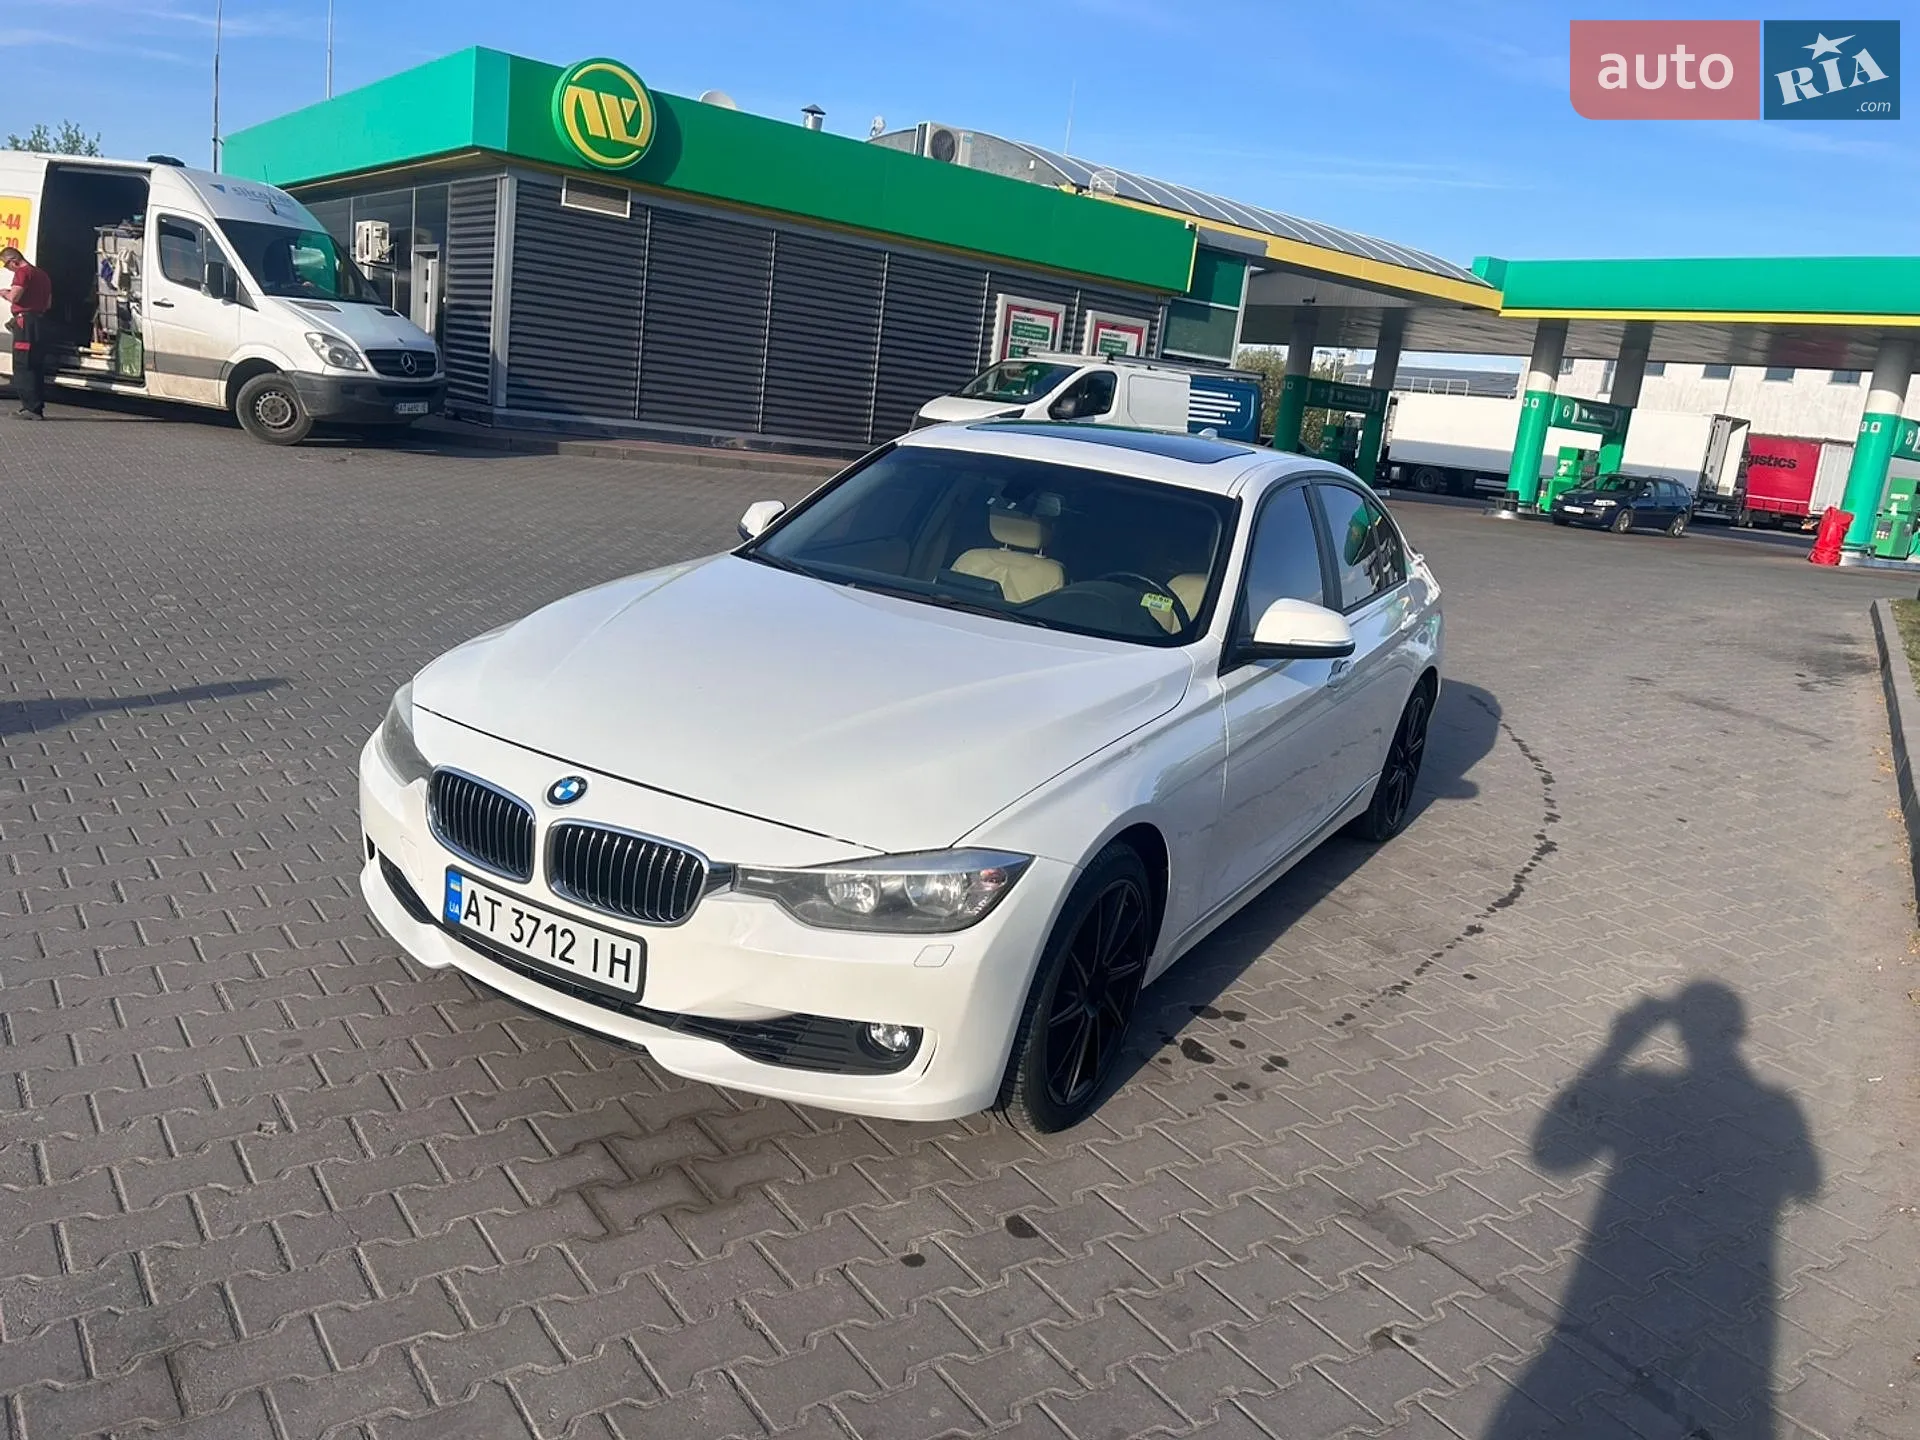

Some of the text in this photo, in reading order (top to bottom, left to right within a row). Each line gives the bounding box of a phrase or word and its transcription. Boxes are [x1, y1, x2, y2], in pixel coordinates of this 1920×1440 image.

[1747, 453, 1798, 470] gistics
[448, 901, 460, 916] UA
[463, 889, 632, 984] AT 3712 IH
